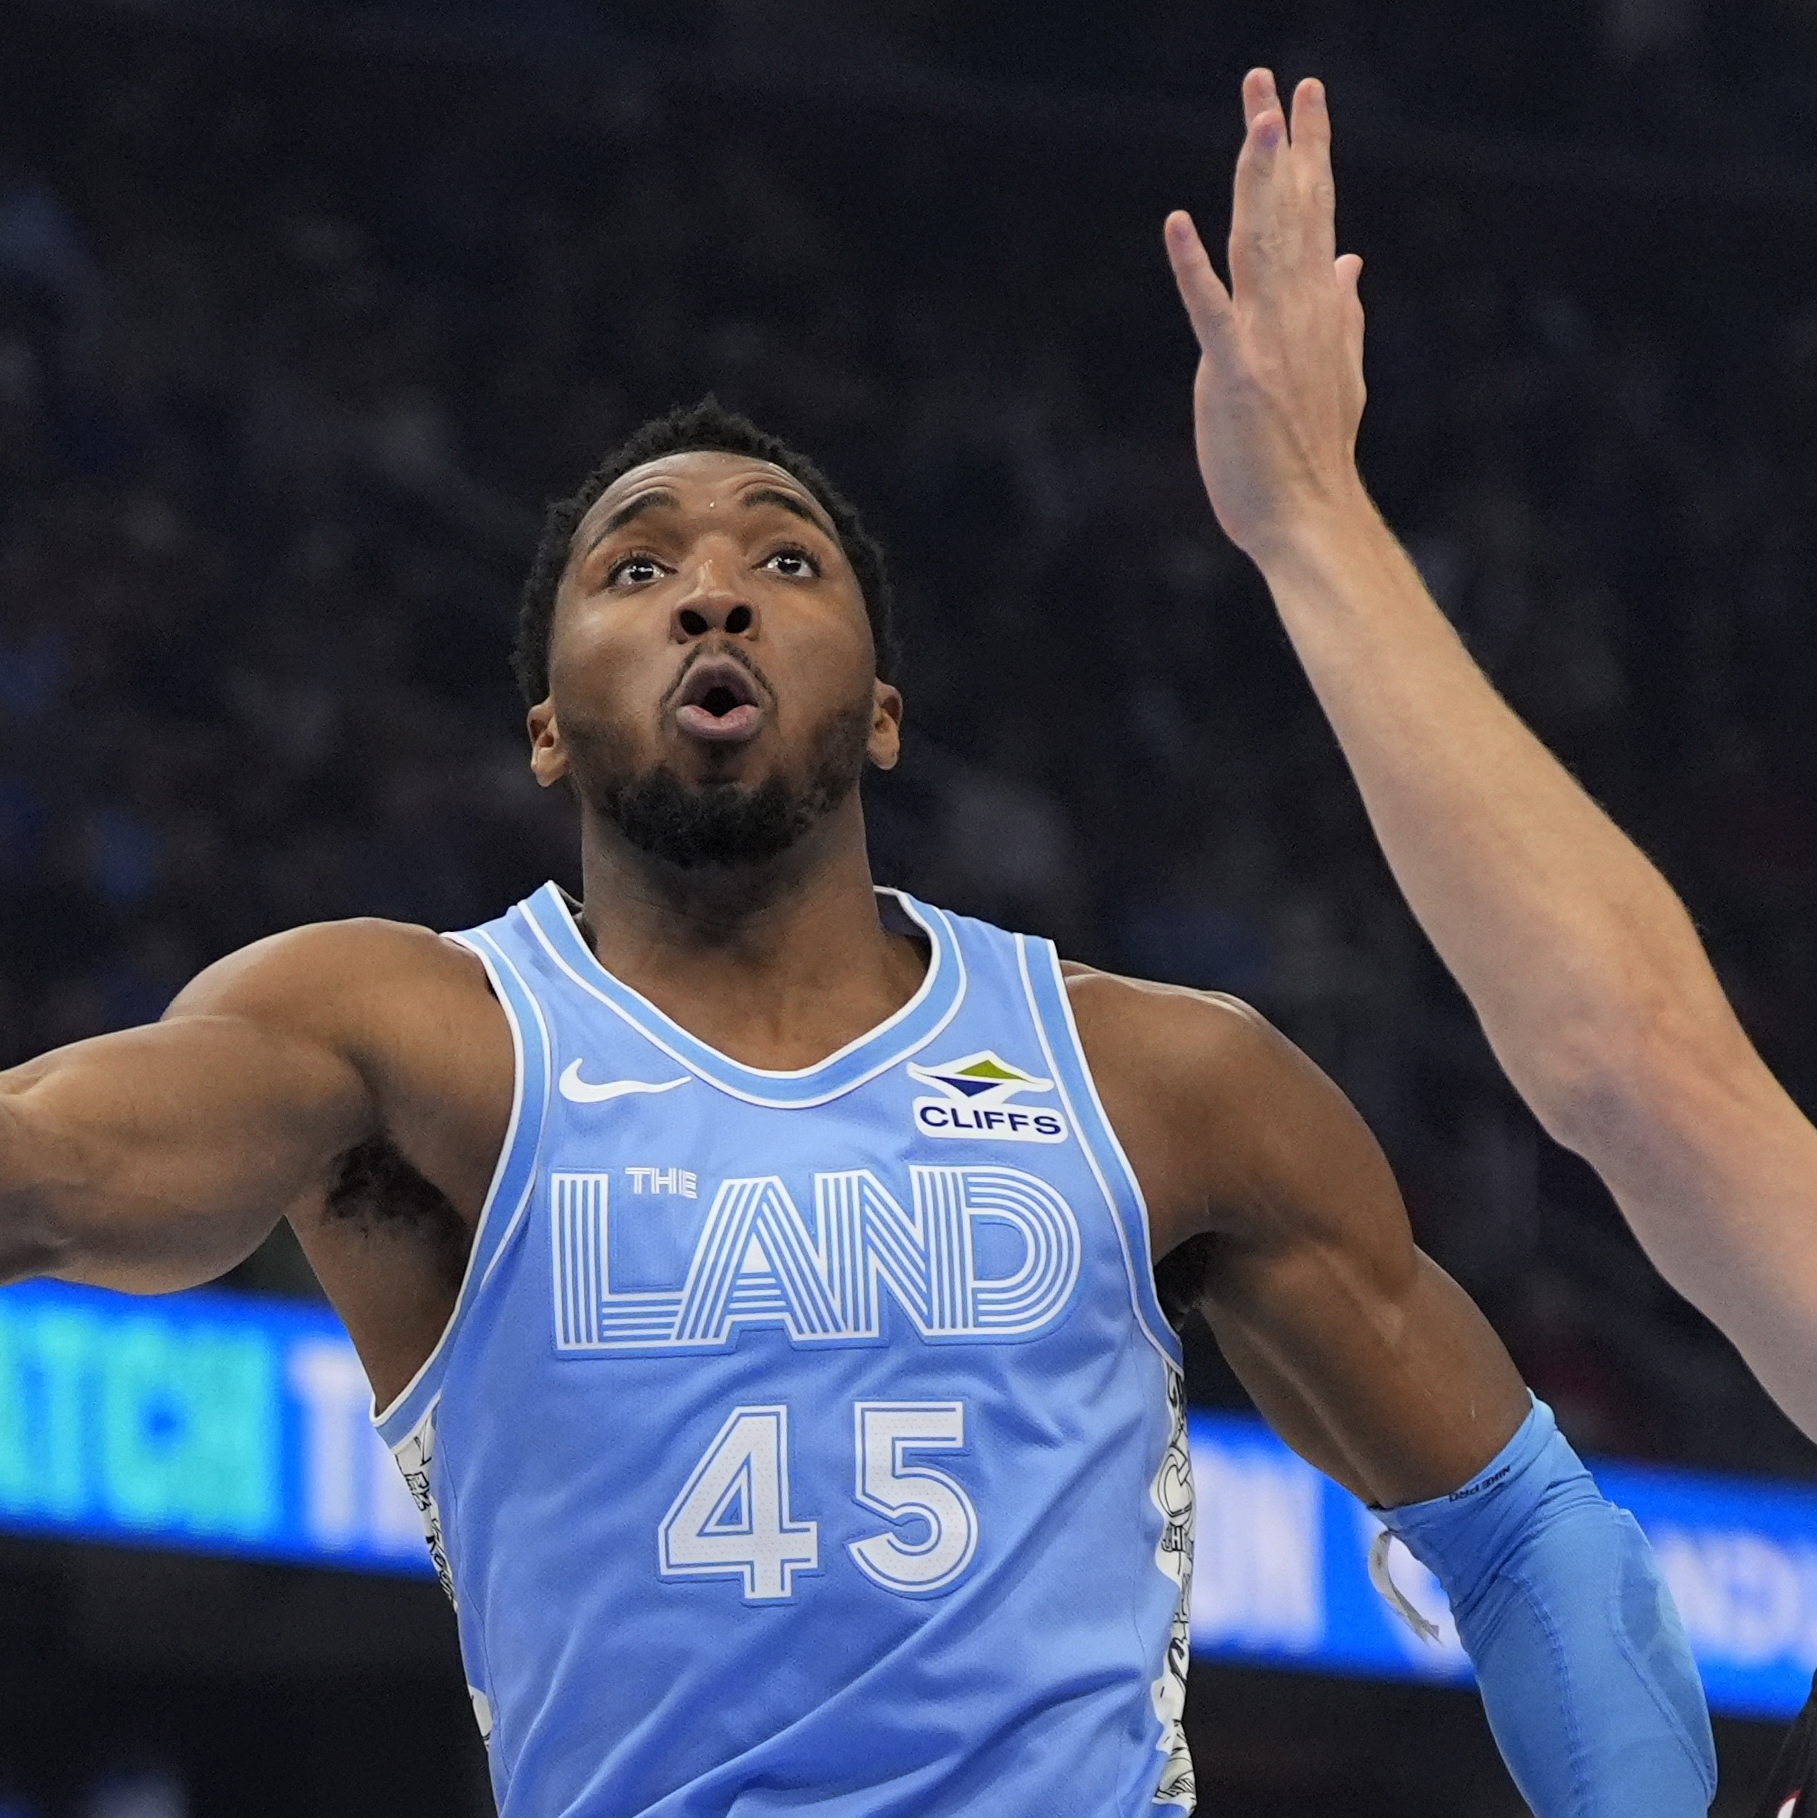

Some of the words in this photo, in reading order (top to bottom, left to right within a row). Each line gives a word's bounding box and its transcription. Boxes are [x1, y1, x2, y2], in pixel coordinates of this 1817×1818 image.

[919, 1105, 1061, 1136] CLIFFS
[624, 1167, 698, 1200] THE
[551, 1164, 1081, 1351] LAND
[657, 1401, 979, 1599] 45
